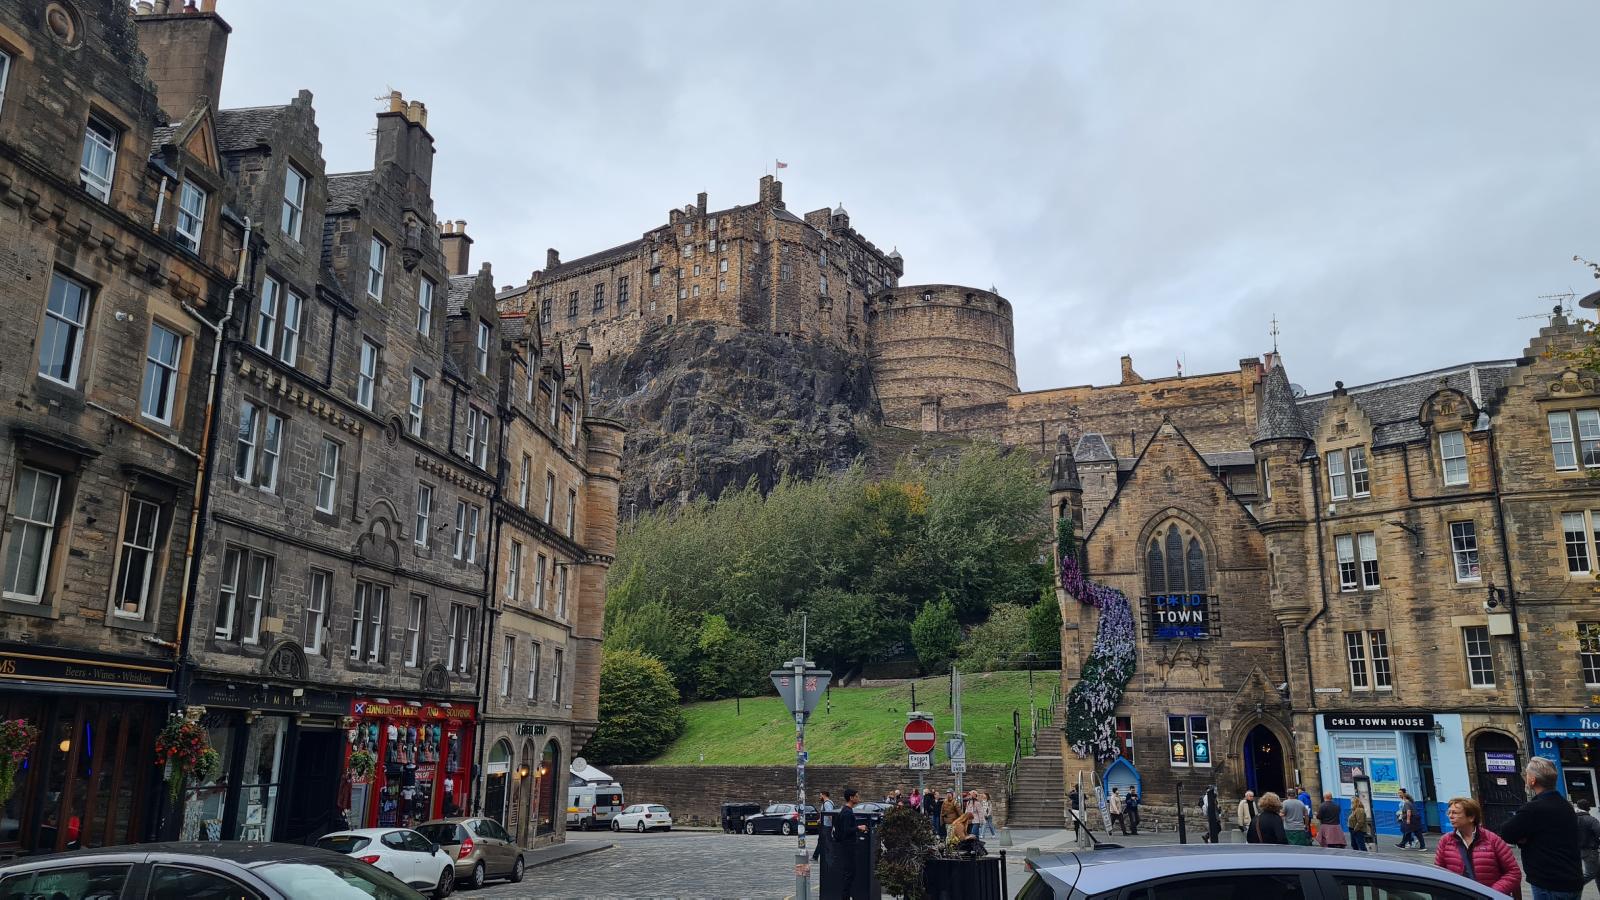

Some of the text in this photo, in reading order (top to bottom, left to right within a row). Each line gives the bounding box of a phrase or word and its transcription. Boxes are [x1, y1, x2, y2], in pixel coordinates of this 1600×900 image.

[1157, 610, 1203, 623] TOWN
[65, 666, 87, 678] Beers
[94, 668, 116, 680] Wines
[1360, 718, 1387, 726] TOWN
[1391, 718, 1425, 726] HOUSE
[1539, 740, 1553, 749] 10
